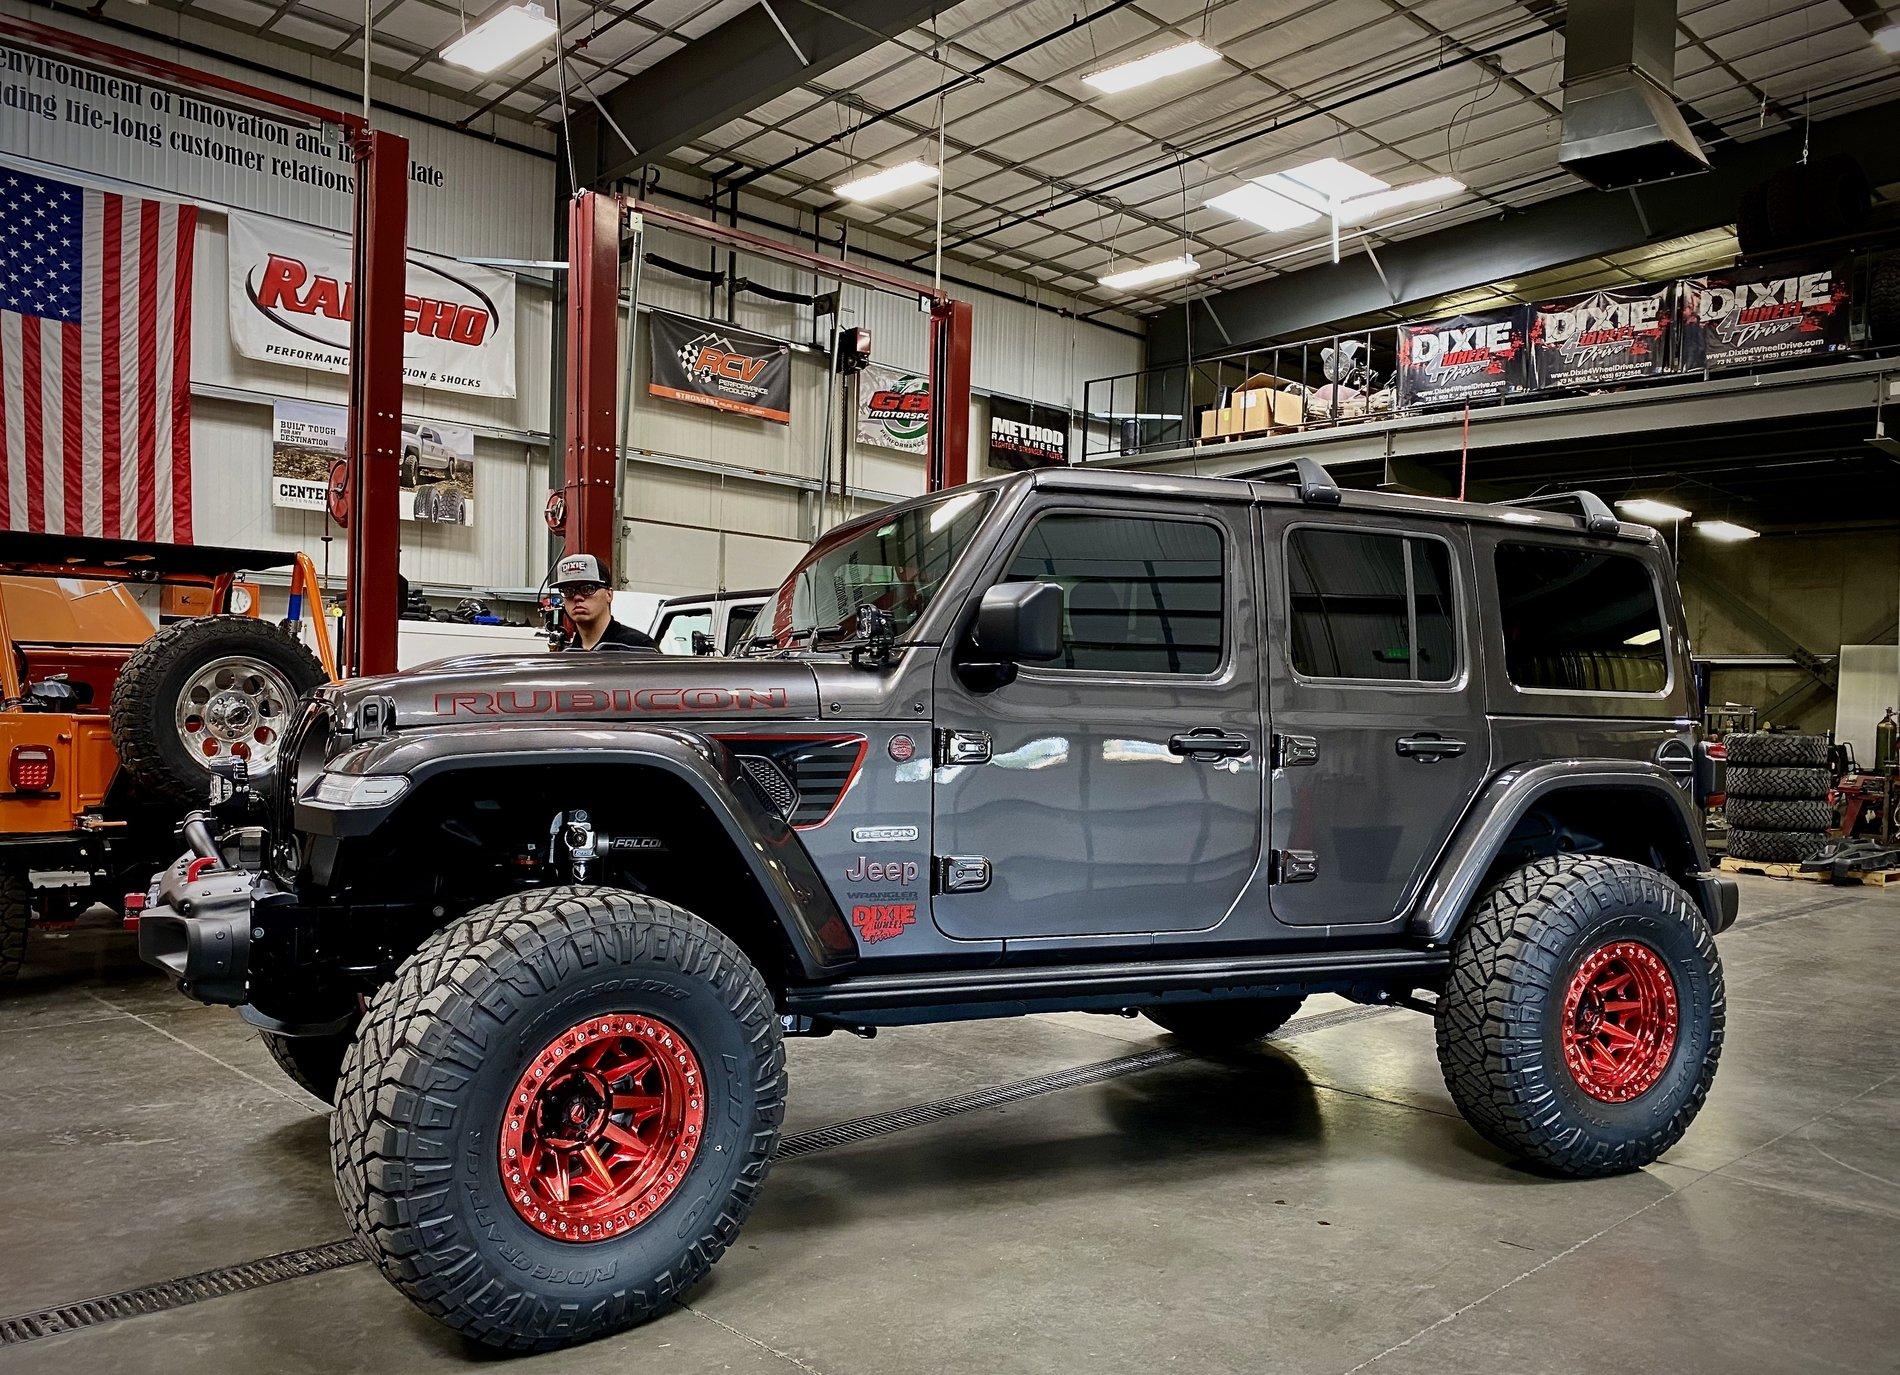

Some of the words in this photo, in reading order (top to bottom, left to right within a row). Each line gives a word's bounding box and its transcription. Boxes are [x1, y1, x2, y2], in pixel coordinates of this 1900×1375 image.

[0, 48, 143, 106] environment
[150, 90, 171, 114] of
[178, 98, 289, 147] innovation
[65, 98, 162, 148] life-long
[170, 131, 265, 172] customer
[257, 253, 490, 347] RAHO
[1701, 271, 1833, 322] DIXIE
[1545, 299, 1660, 344] DIXIE
[1739, 301, 1804, 325] WHEEL
[1412, 321, 1513, 364] DIXIE
[1578, 325, 1635, 346] WHEEL
[1440, 346, 1490, 367] WHEEL
[1705, 338, 1825, 362] www.Dixie4WheelDrive.com
[266, 344, 349, 366] PERFORMANC
[429, 372, 437, 381] &
[440, 374, 481, 388] SHOCKS
[693, 346, 768, 383] RCV
[1550, 360, 1653, 380] www.Dixie4WheelDrive.com
[718, 379, 768, 395] PERFORMANCE
[718, 385, 757, 398] PRODUCTS
[280, 421, 305, 431] BUILT
[308, 425, 336, 436] TOUGH
[280, 434, 328, 446] DESTINATION
[992, 417, 1064, 446] METHOD
[991, 433, 1019, 445] RACE
[1023, 439, 1064, 454] WHEELS
[561, 561, 587, 573] DIXIE
[435, 688, 787, 716] RUBICON
[857, 829, 916, 839] RECON
[846, 856, 919, 886] Jeep
[847, 891, 918, 900] WRANGLER
[852, 904, 917, 927] DIXIE
